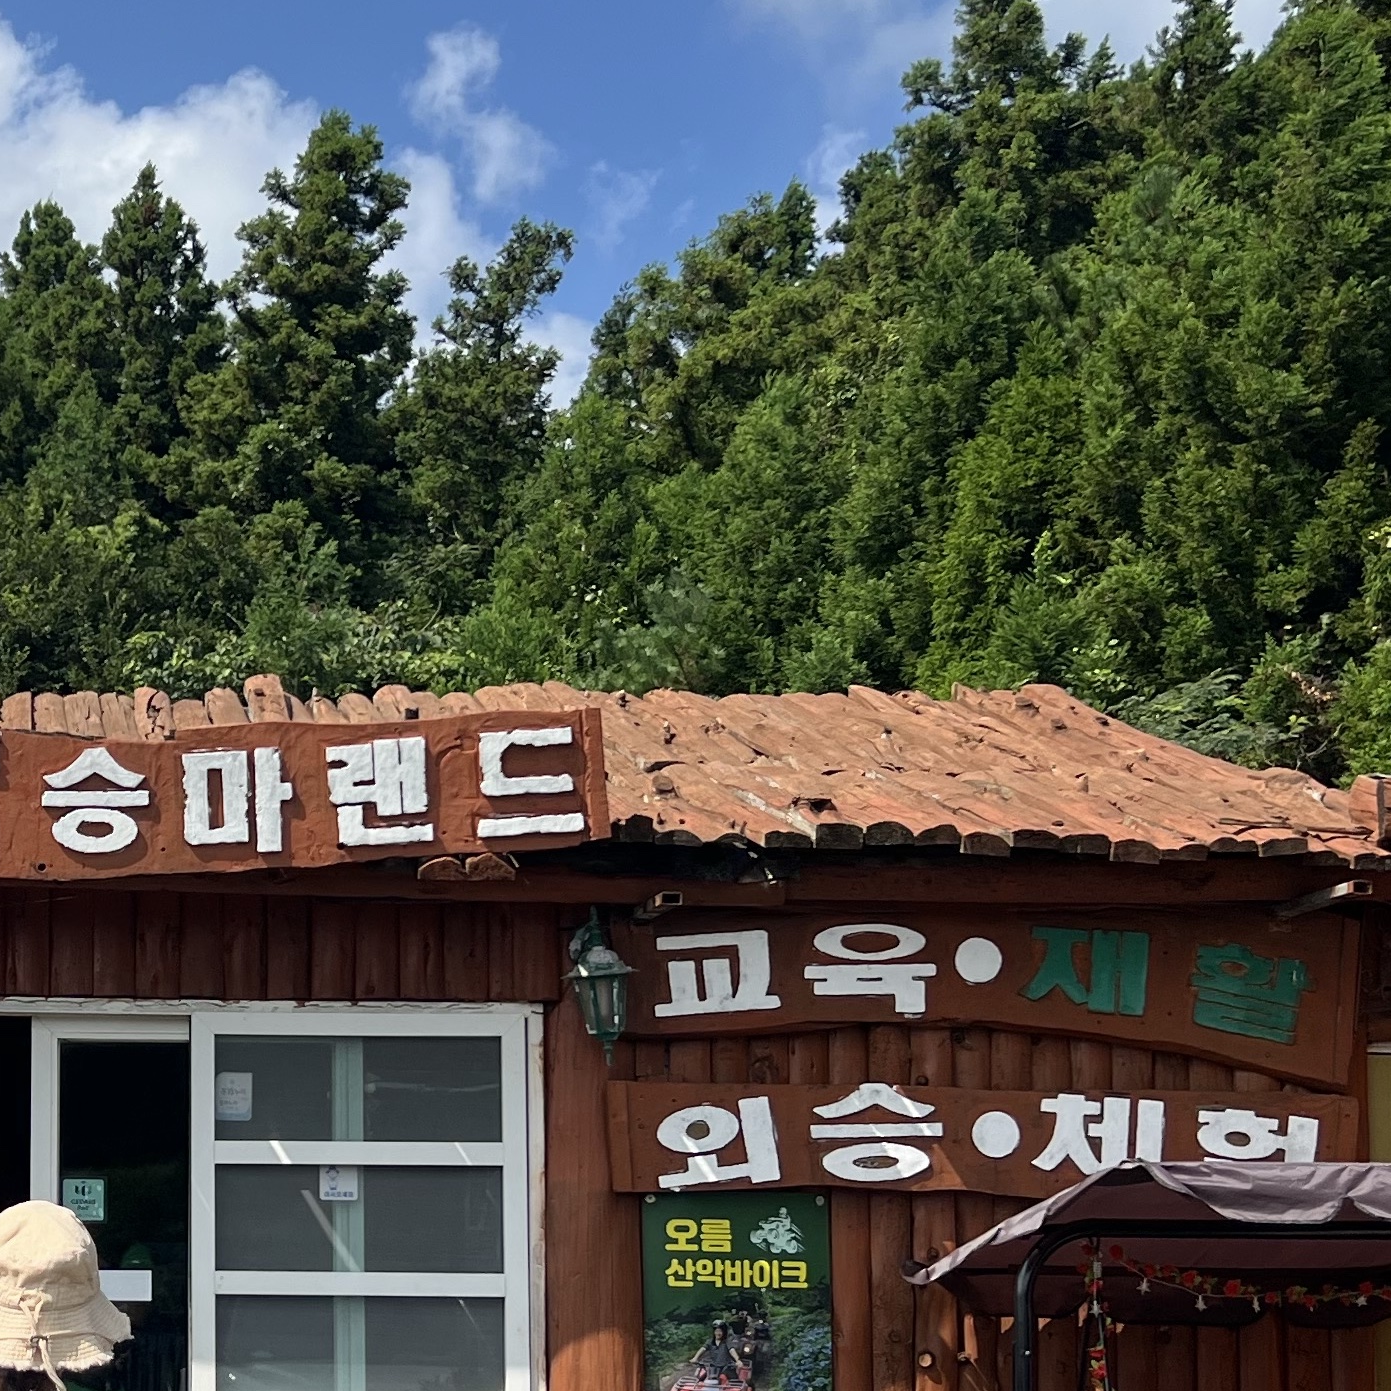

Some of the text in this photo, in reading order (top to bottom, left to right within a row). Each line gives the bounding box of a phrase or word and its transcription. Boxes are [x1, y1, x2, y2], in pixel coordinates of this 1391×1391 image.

[41, 726, 586, 854] 승마랜드
[665, 1218, 733, 1253] 오름
[665, 1258, 808, 1289] 산악바이크
